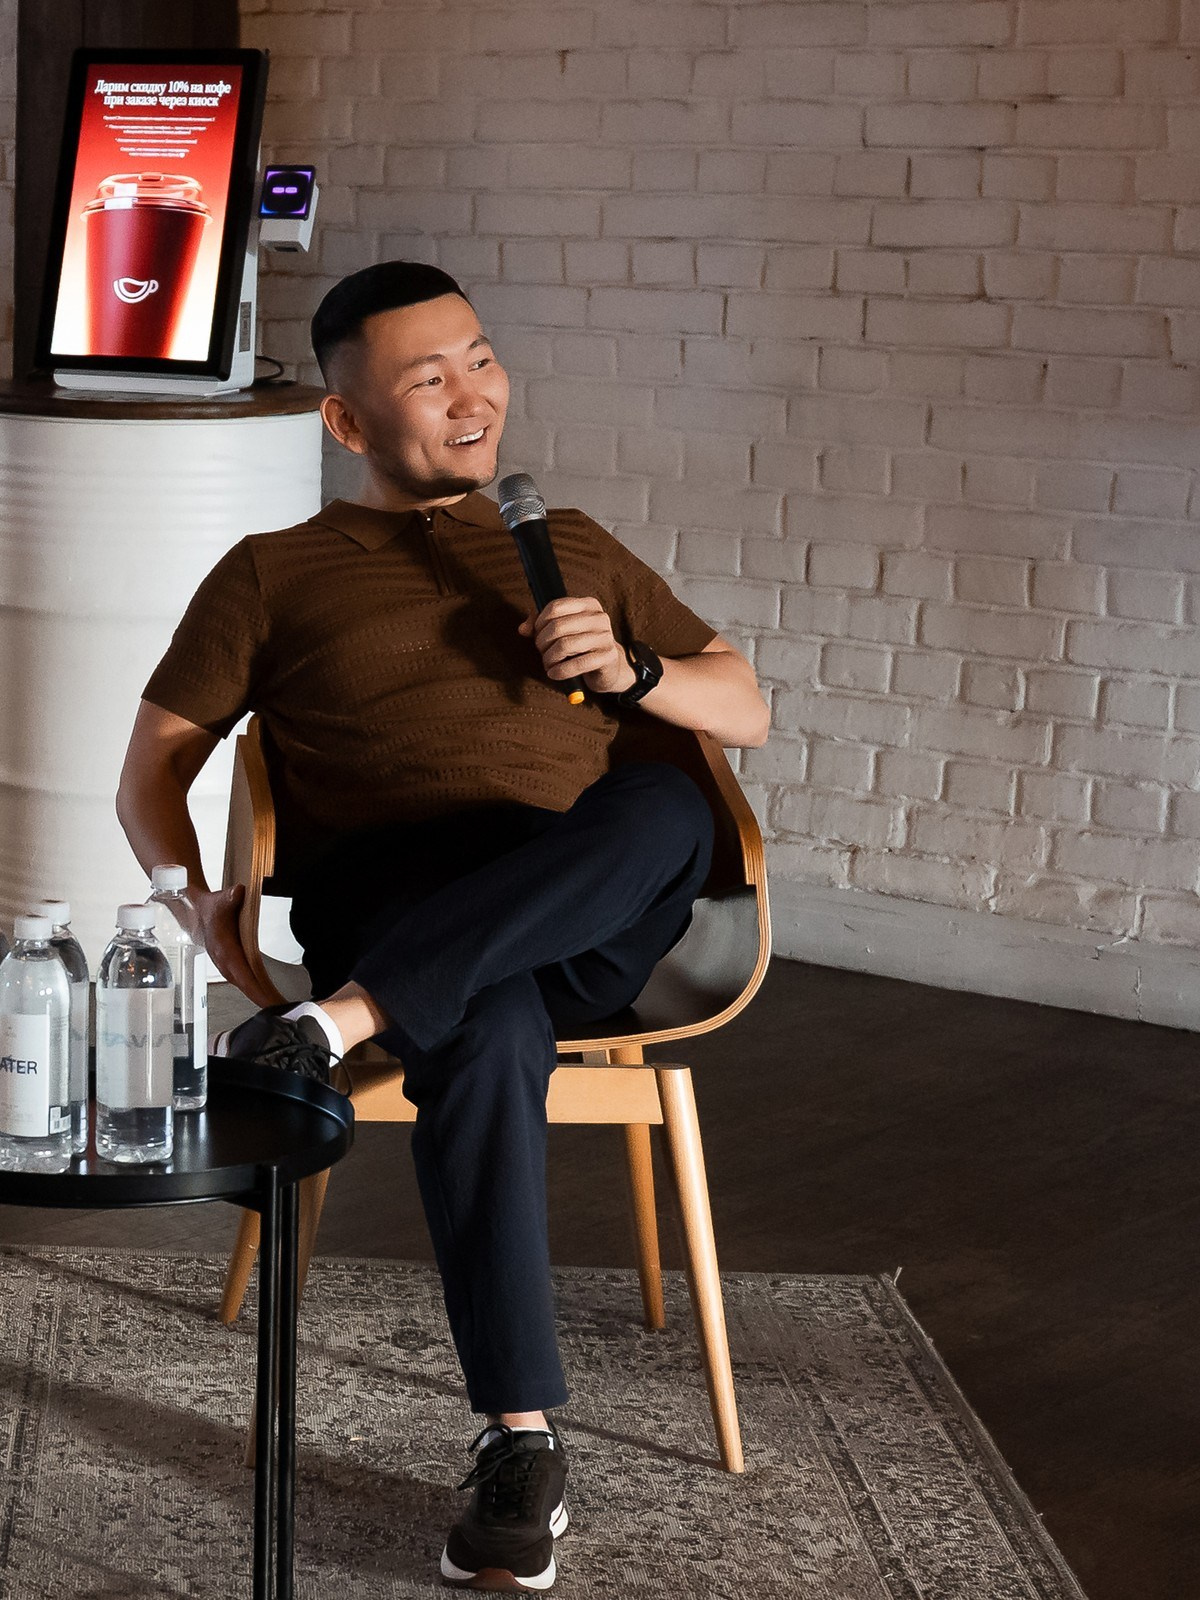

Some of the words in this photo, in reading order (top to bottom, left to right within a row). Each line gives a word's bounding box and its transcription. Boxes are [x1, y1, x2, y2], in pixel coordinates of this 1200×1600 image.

[95, 80, 130, 95] Дарим
[130, 83, 167, 96] скидку
[168, 81, 190, 93] 10%
[190, 84, 204, 93] на
[205, 80, 231, 97] кофе
[104, 96, 125, 109] при
[125, 96, 158, 106] заказе
[159, 97, 187, 110] через
[188, 97, 219, 107] киоск
